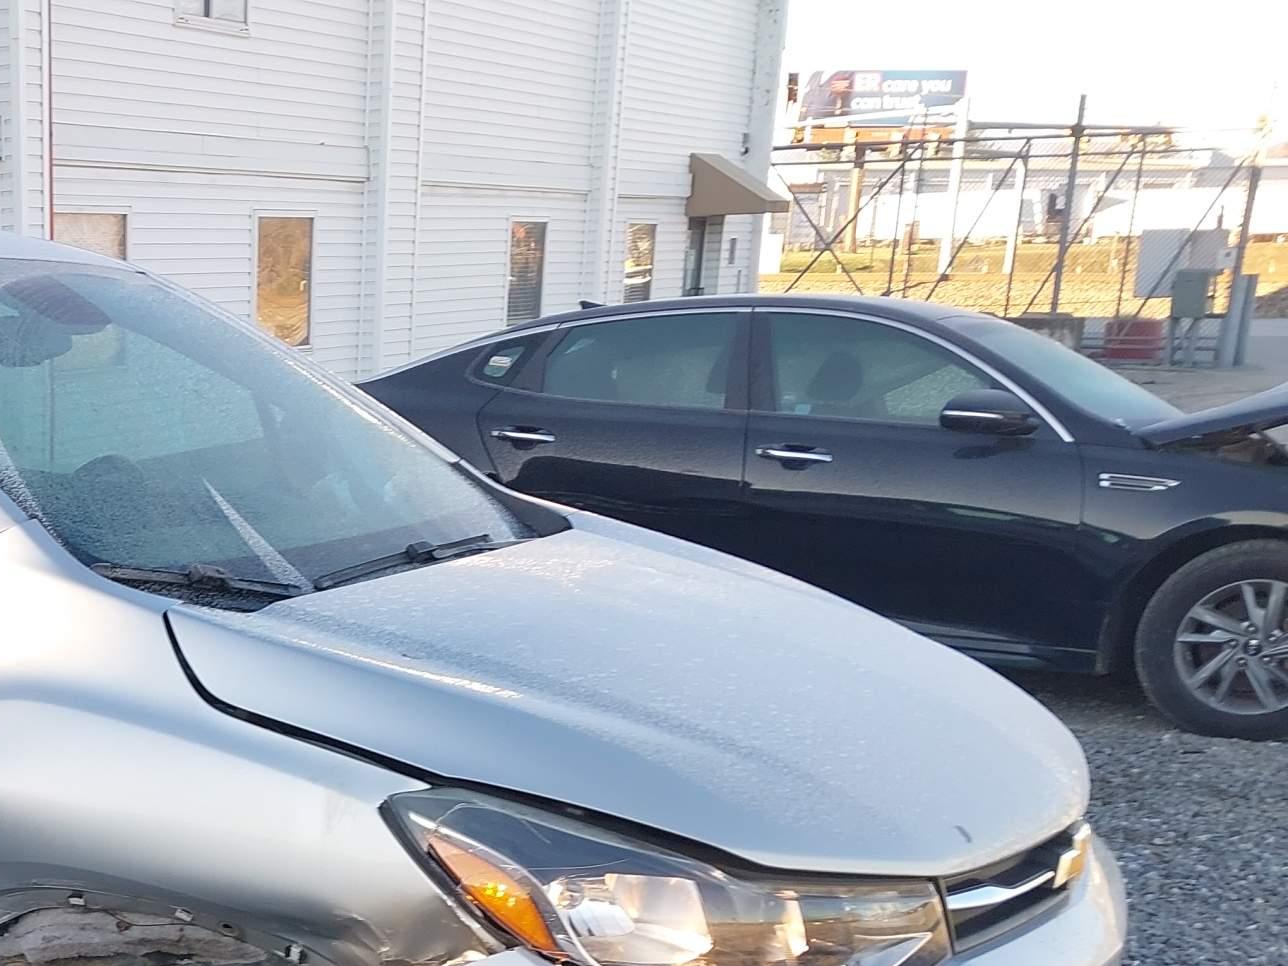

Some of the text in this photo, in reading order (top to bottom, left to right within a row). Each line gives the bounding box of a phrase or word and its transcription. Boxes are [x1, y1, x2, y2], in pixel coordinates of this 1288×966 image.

[881, 79, 919, 94] care
[920, 79, 952, 96] you
[850, 96, 881, 110] can
